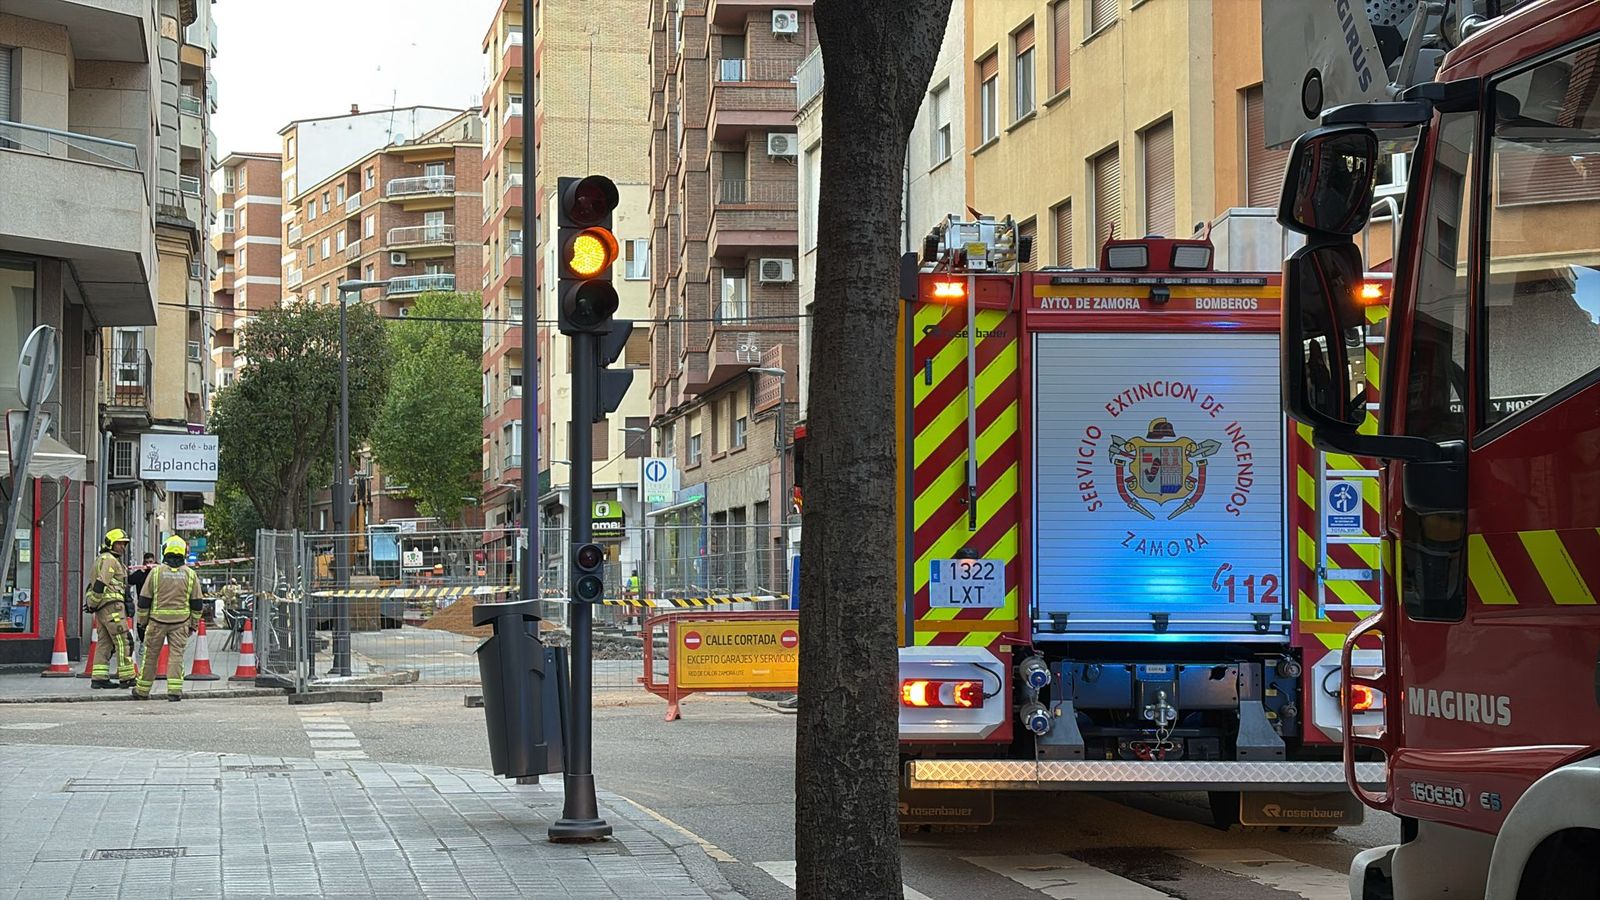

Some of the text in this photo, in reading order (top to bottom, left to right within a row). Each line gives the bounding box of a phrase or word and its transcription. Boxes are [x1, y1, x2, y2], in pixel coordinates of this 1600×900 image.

[1040, 297, 1140, 309] AYTO. DE ZAMORA
[1195, 298, 1258, 310] BOMBEROS
[179, 442, 196, 451] café
[203, 442, 216, 451] bar
[1076, 380, 1254, 517] SERVICIO EXTINCION DE INCENDIOS
[1121, 530, 1209, 557] ZAMORA
[950, 562, 995, 580] 1322
[1223, 573, 1279, 603] 112
[949, 585, 985, 604] LXT
[706, 634, 777, 646] CALLE CORTADA
[687, 653, 796, 664] EXCEPTO GARAJES Y SERVICIOS
[1408, 687, 1511, 726] MAGIRUS
[910, 805, 973, 816] rosenbauer
[1282, 806, 1344, 818] rosenbauer
